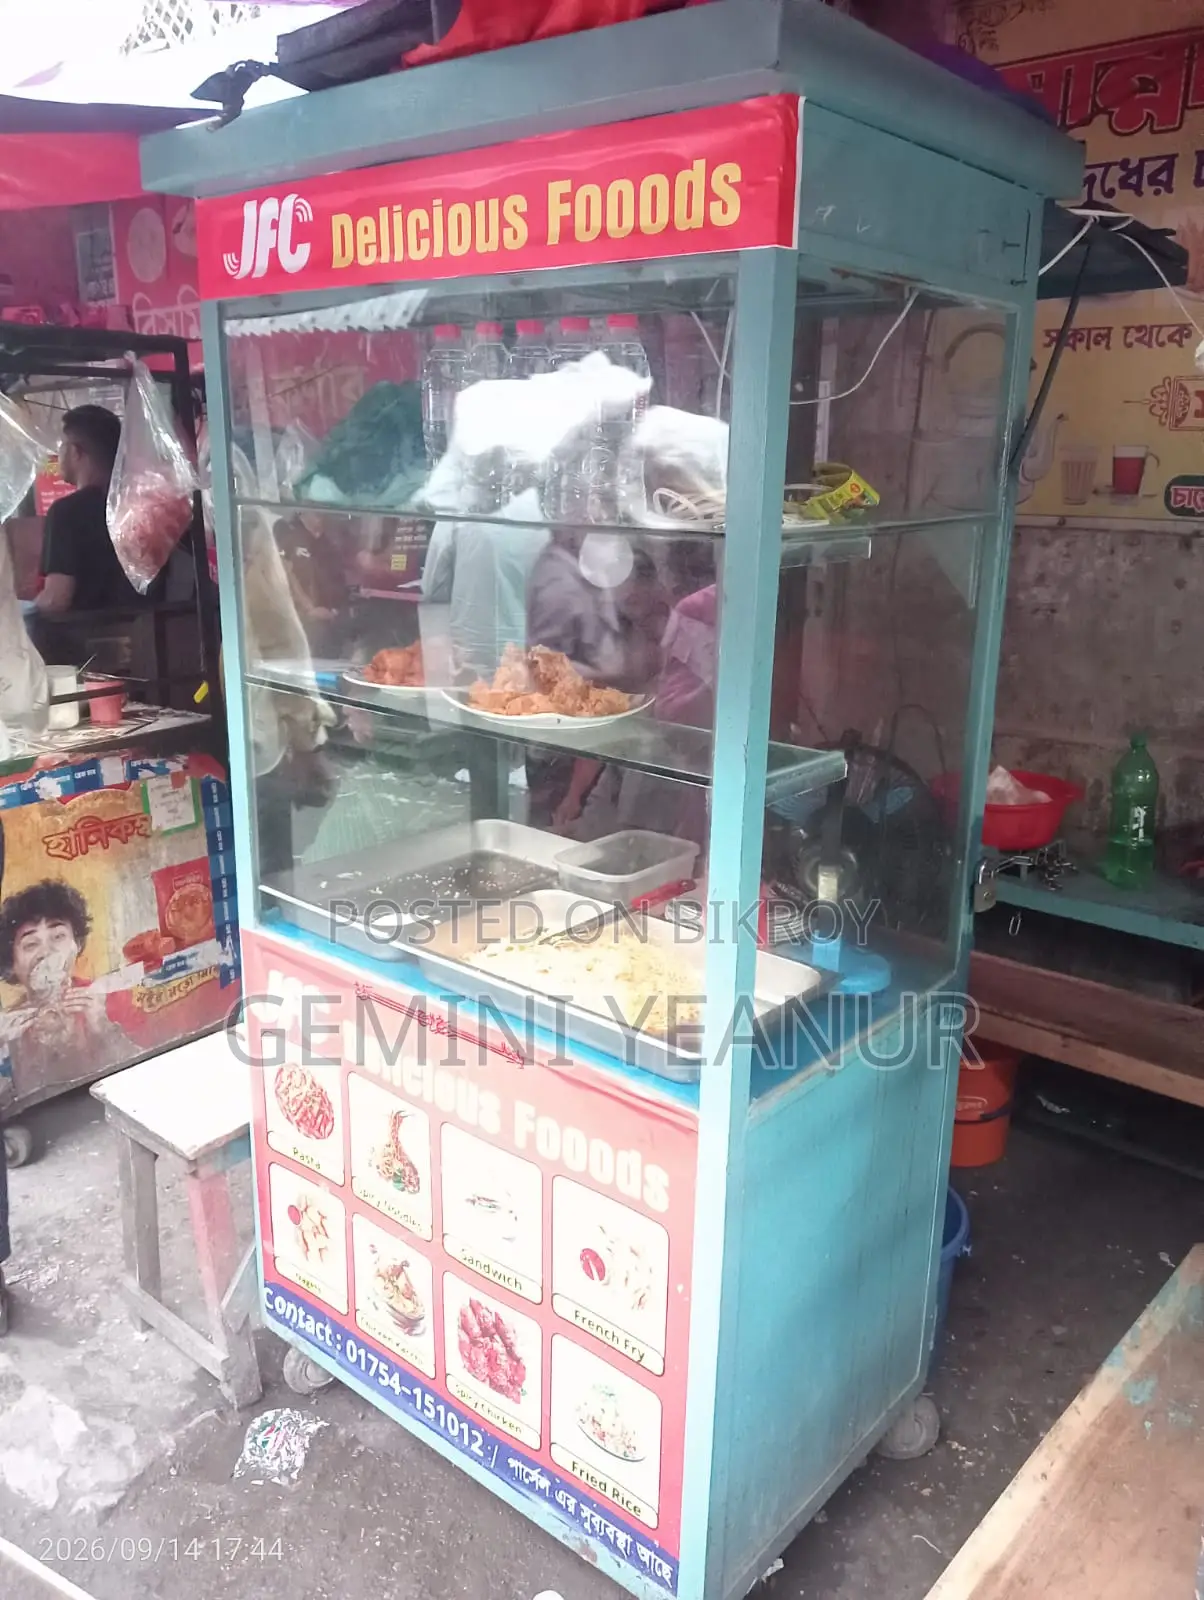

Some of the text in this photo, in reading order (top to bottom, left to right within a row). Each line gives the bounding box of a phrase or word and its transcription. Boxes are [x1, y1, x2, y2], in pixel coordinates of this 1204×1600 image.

[1084, 153, 1178, 202] দধের
[223, 158, 742, 279] JFC Delicious Fooods
[1043, 322, 1194, 350] সকাল থেকে
[513, 1100, 670, 1213] Fooods
[574, 1308, 645, 1363] French Fry
[346, 1339, 484, 1457] 01754-151012
[555, 1489, 578, 1516] এর
[636, 1541, 673, 1588] আছে
[571, 1460, 642, 1518] Fried Rice
